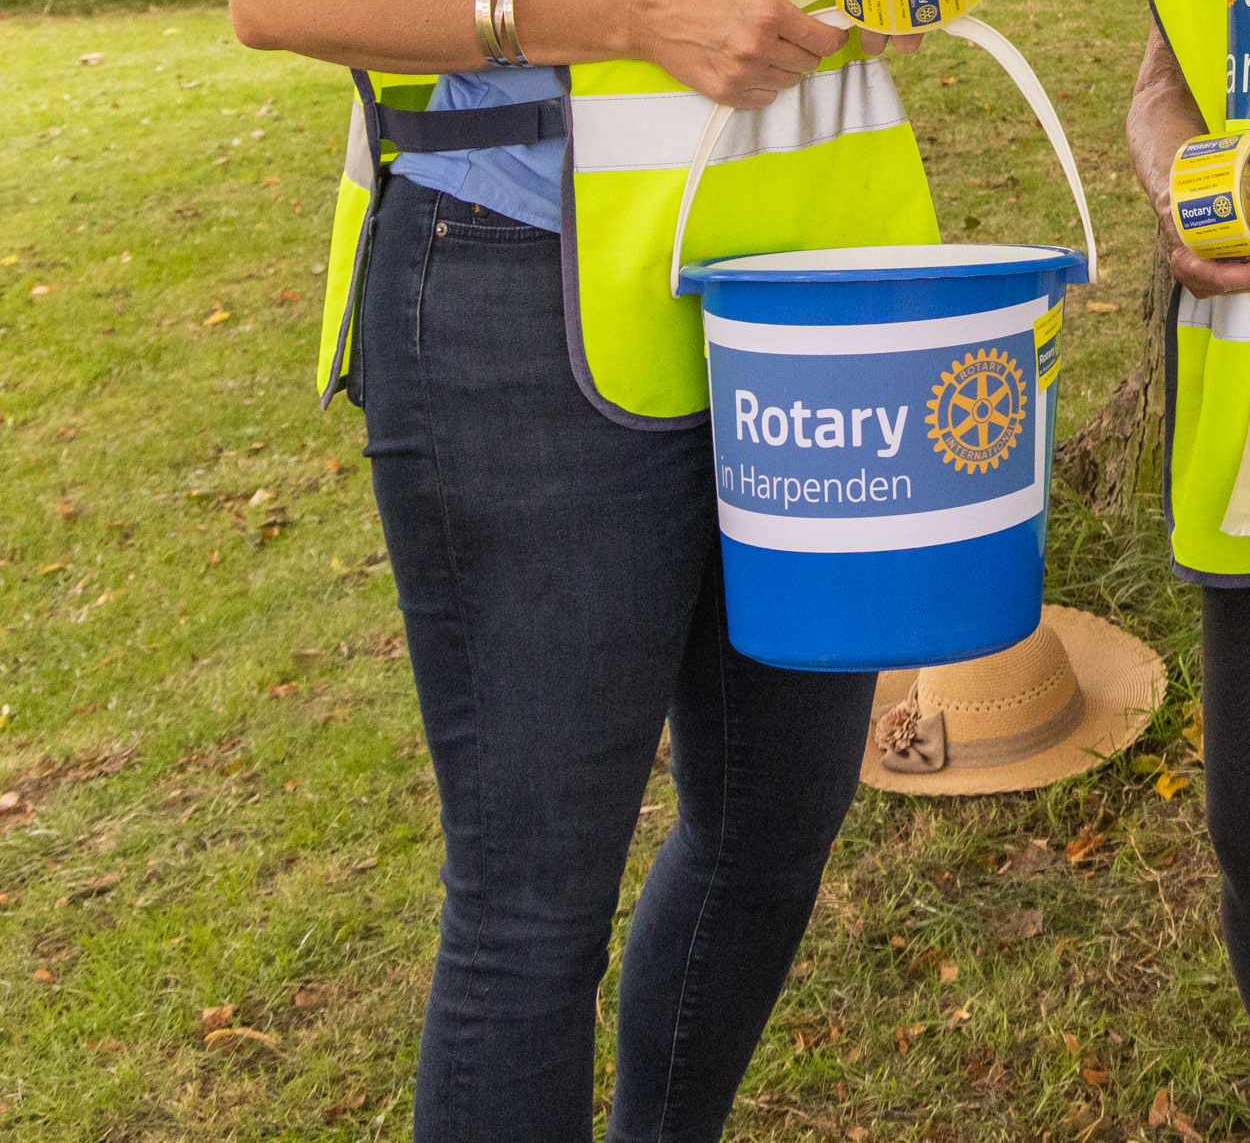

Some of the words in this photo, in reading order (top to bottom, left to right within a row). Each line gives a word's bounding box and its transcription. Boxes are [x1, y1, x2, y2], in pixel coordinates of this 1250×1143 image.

[1187, 141, 1218, 151] Rotary
[1177, 177, 1195, 185] CLASSICS
[1211, 171, 1230, 179] COMMON
[1189, 185, 1212, 193] ORGANISED
[1182, 205, 1212, 219] Rotary
[1190, 217, 1216, 227] Harpenden
[1039, 346, 1055, 365] Rotary
[960, 363, 1003, 380] ROTARY
[735, 389, 909, 457] Rotary
[945, 422, 1017, 460] INTERNATIONAL
[720, 455, 734, 492] in
[741, 463, 912, 510] Harpenden
